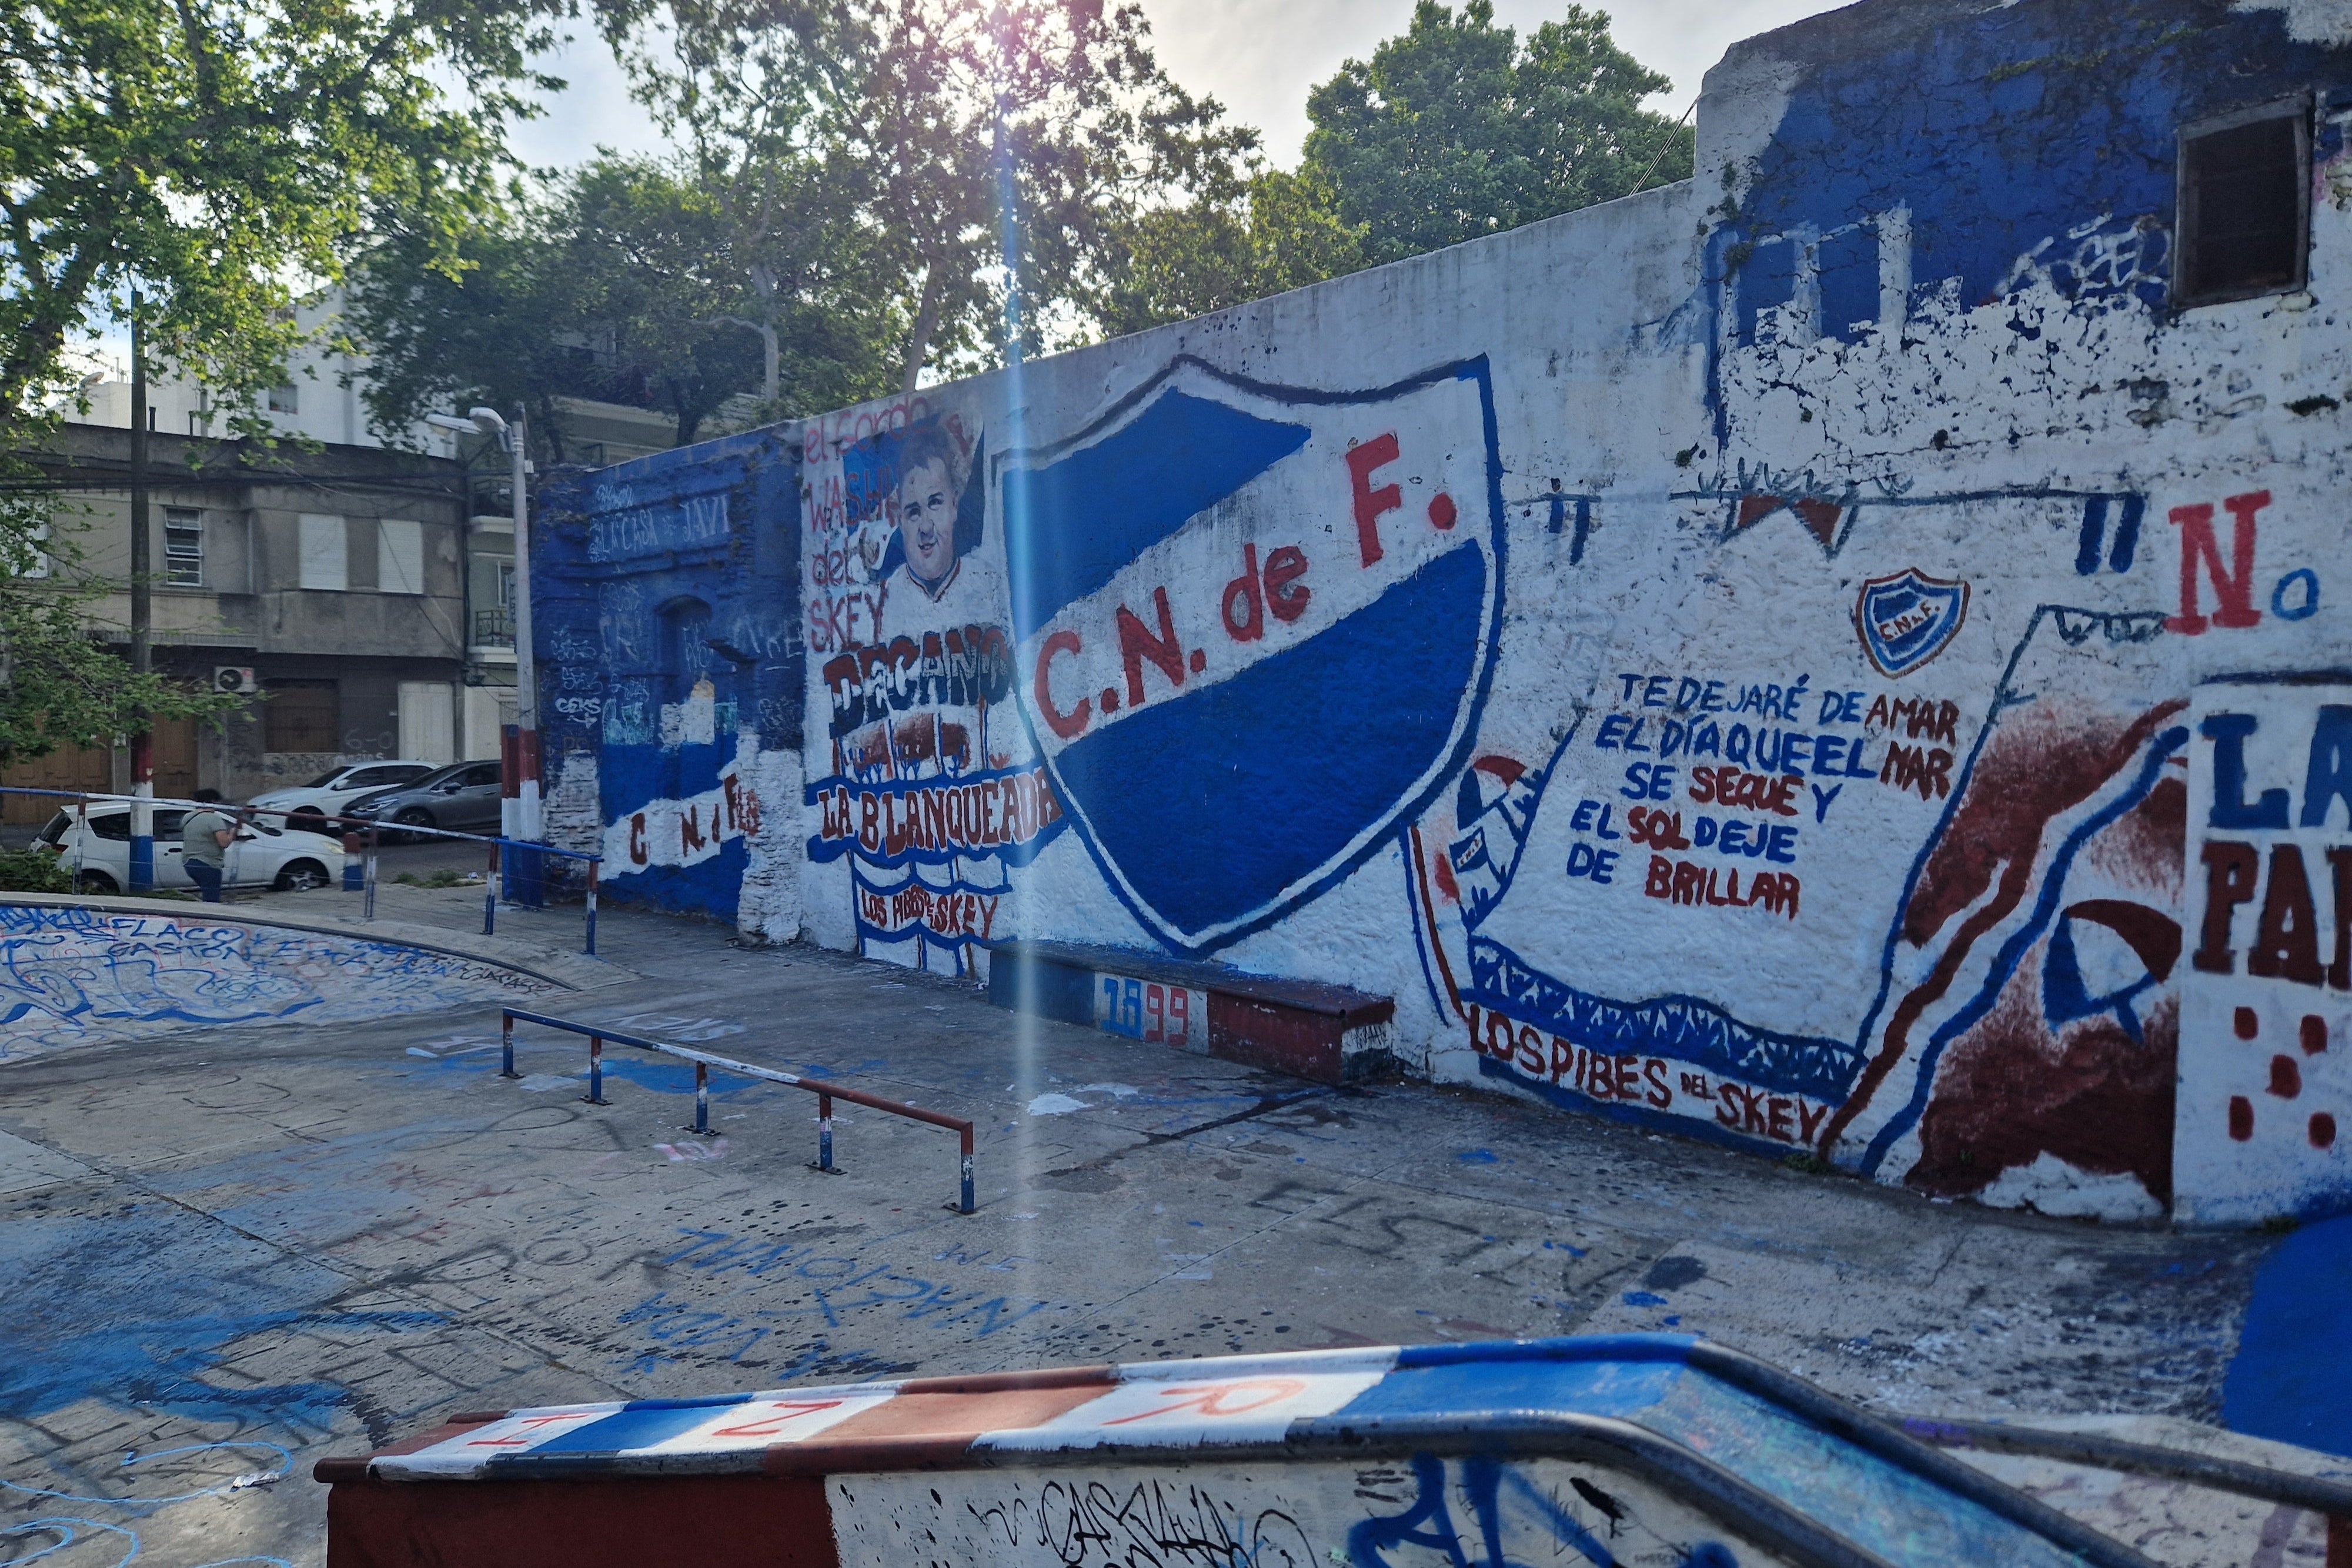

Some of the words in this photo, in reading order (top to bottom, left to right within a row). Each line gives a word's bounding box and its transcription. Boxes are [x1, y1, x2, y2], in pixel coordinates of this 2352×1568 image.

[679, 494, 730, 542] JAVI
[1222, 543, 1310, 641] de
[1346, 432, 1457, 569] F.
[810, 579, 888, 653] SKEY
[823, 623, 1010, 739] DECANO
[1619, 673, 1672, 706] TE
[1677, 673, 1810, 723] DEJARÉ
[1818, 689, 1866, 724] DE
[1864, 694, 1960, 748] AMAR
[1595, 714, 1651, 752] EL
[1725, 727, 1816, 776] QUE
[1812, 734, 1877, 779] EL
[1880, 740, 1955, 801] MAR
[1619, 763, 1677, 800] SE
[1689, 766, 1804, 817] SEQUE
[1812, 783, 1843, 823] Y
[2198, 704, 2352, 829] LA
[818, 787, 853, 839] LA
[859, 767, 1063, 856] BLANQUEADA
[1570, 799, 1620, 840] EL
[1627, 805, 1690, 851] SOL
[1693, 815, 1798, 864] DEJE
[861, 888, 887, 927] LOS
[935, 892, 998, 940] SKEY
[1566, 842, 1619, 883] DE
[1645, 854, 1800, 921] BRILLAR
[112, 918, 245, 942] FLACO
[1101, 978, 1188, 1047] 1899
[1469, 1004, 1546, 1075] LOS
[1551, 1047, 1672, 1109] PIBES
[1680, 1072, 1716, 1099] DEL
[1715, 1082, 1830, 1146] SKEY
[660, 1228, 1049, 1337] NACIONAL
